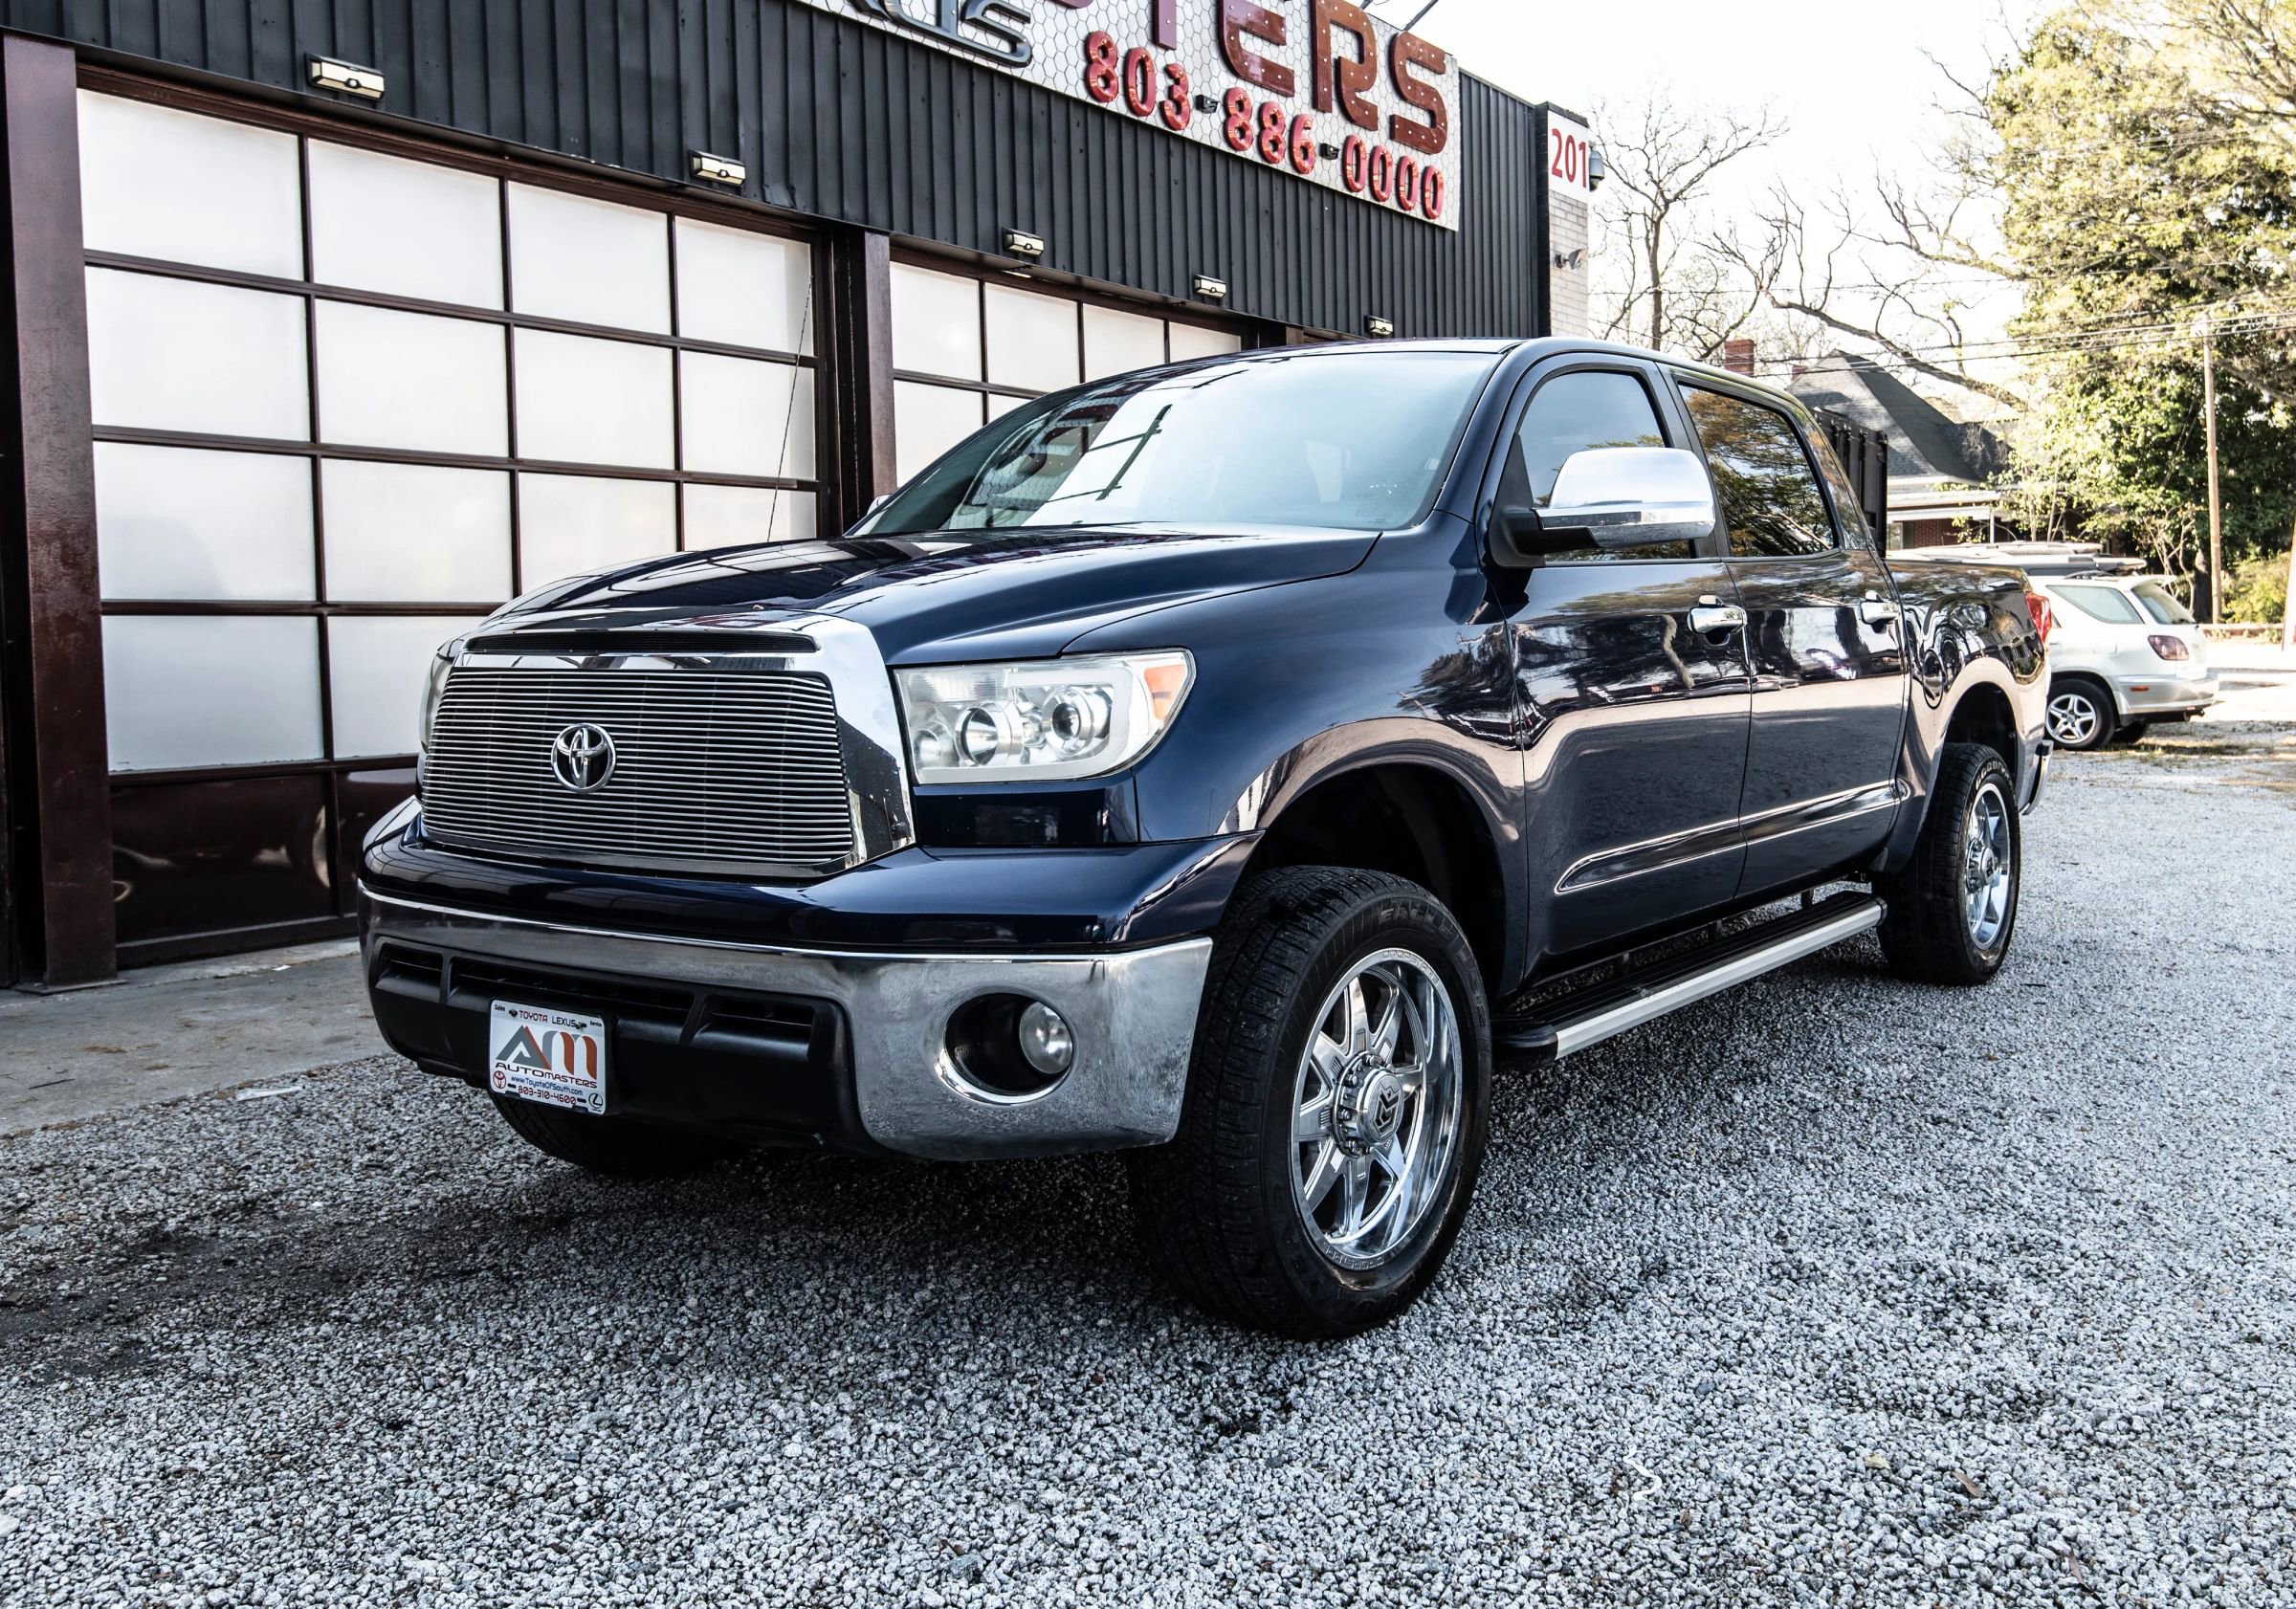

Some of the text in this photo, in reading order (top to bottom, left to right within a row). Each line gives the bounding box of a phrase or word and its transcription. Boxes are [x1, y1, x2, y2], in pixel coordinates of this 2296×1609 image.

[1086, 30, 1446, 220] 803-886-0000
[1552, 128, 1586, 188] 201
[1379, 906, 1453, 939] EAGLE
[519, 1010, 576, 1027] TOYOTA LEXUS
[495, 1062, 598, 1089] AUTOMASTERS
[518, 1085, 577, 1106] 803-310-4600
